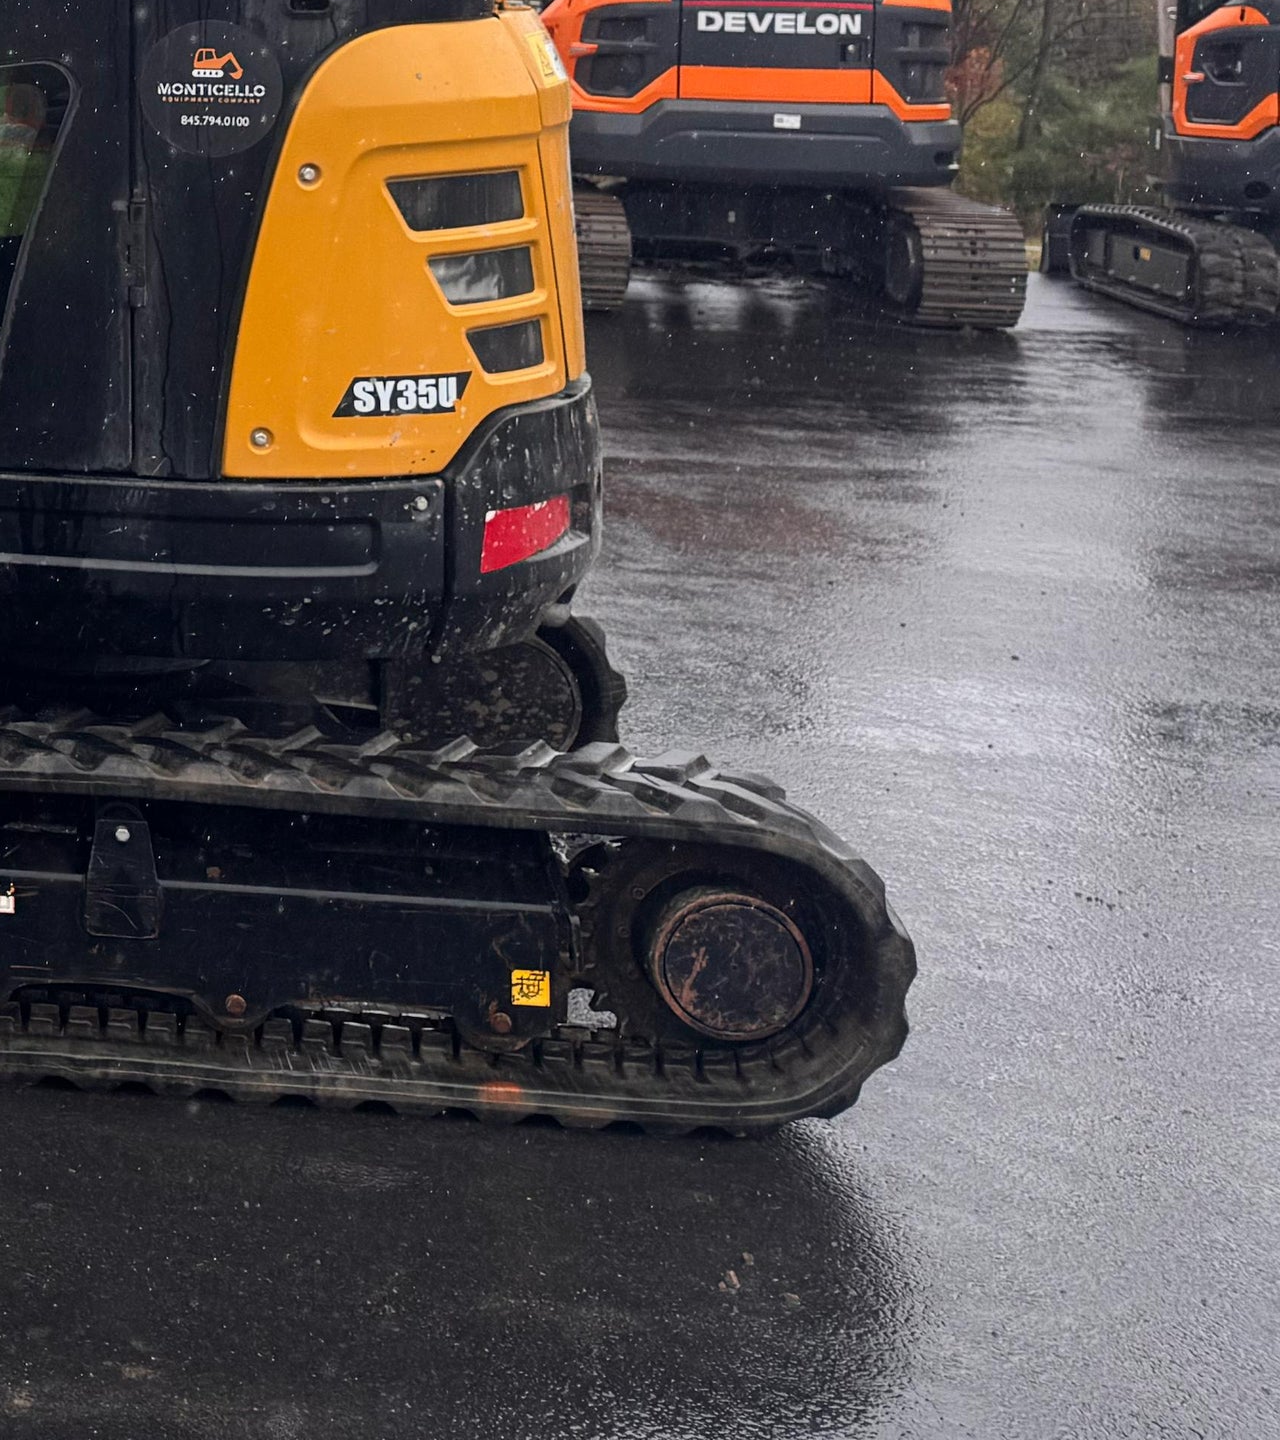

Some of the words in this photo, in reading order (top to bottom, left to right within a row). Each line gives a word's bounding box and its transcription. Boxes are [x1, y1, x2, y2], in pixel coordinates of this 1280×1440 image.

[697, 10, 863, 35] DEVELON
[157, 82, 267, 97] MONTICELLO
[180, 114, 251, 127] 845.794.0100
[353, 376, 458, 413] SY35U
